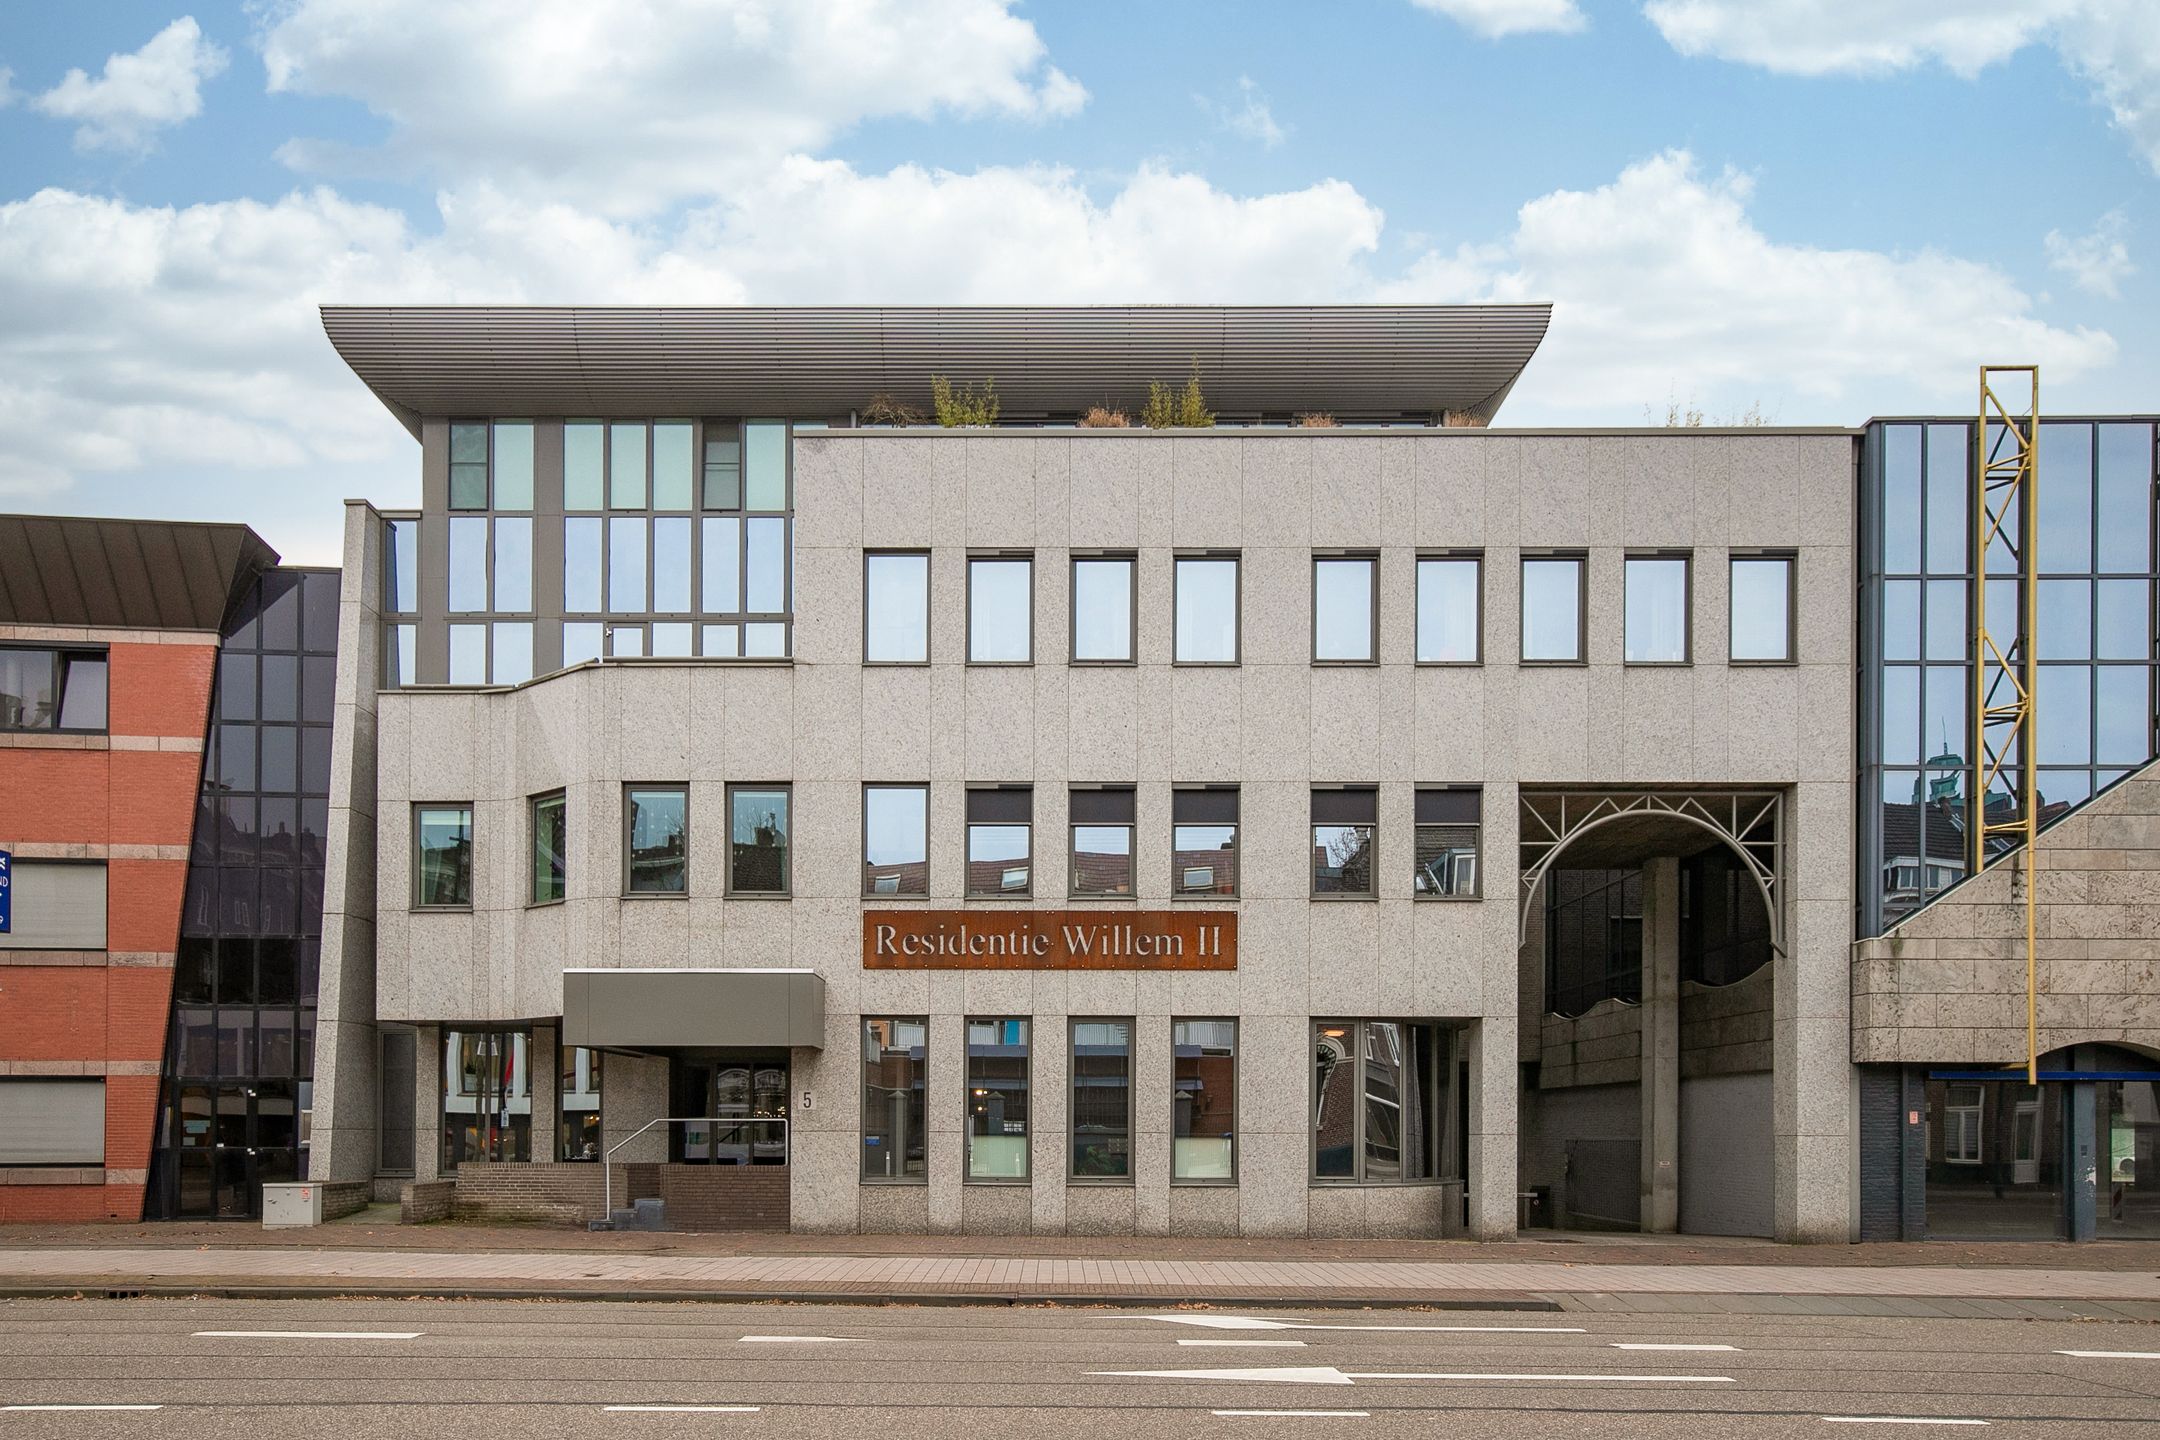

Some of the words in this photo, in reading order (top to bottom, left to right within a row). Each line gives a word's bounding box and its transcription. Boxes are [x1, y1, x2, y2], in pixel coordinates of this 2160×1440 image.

[875, 925, 1049, 955] Residentie
[1062, 925, 1184, 955] Willem
[1198, 926, 1222, 955] II
[803, 1092, 812, 1108] 5
